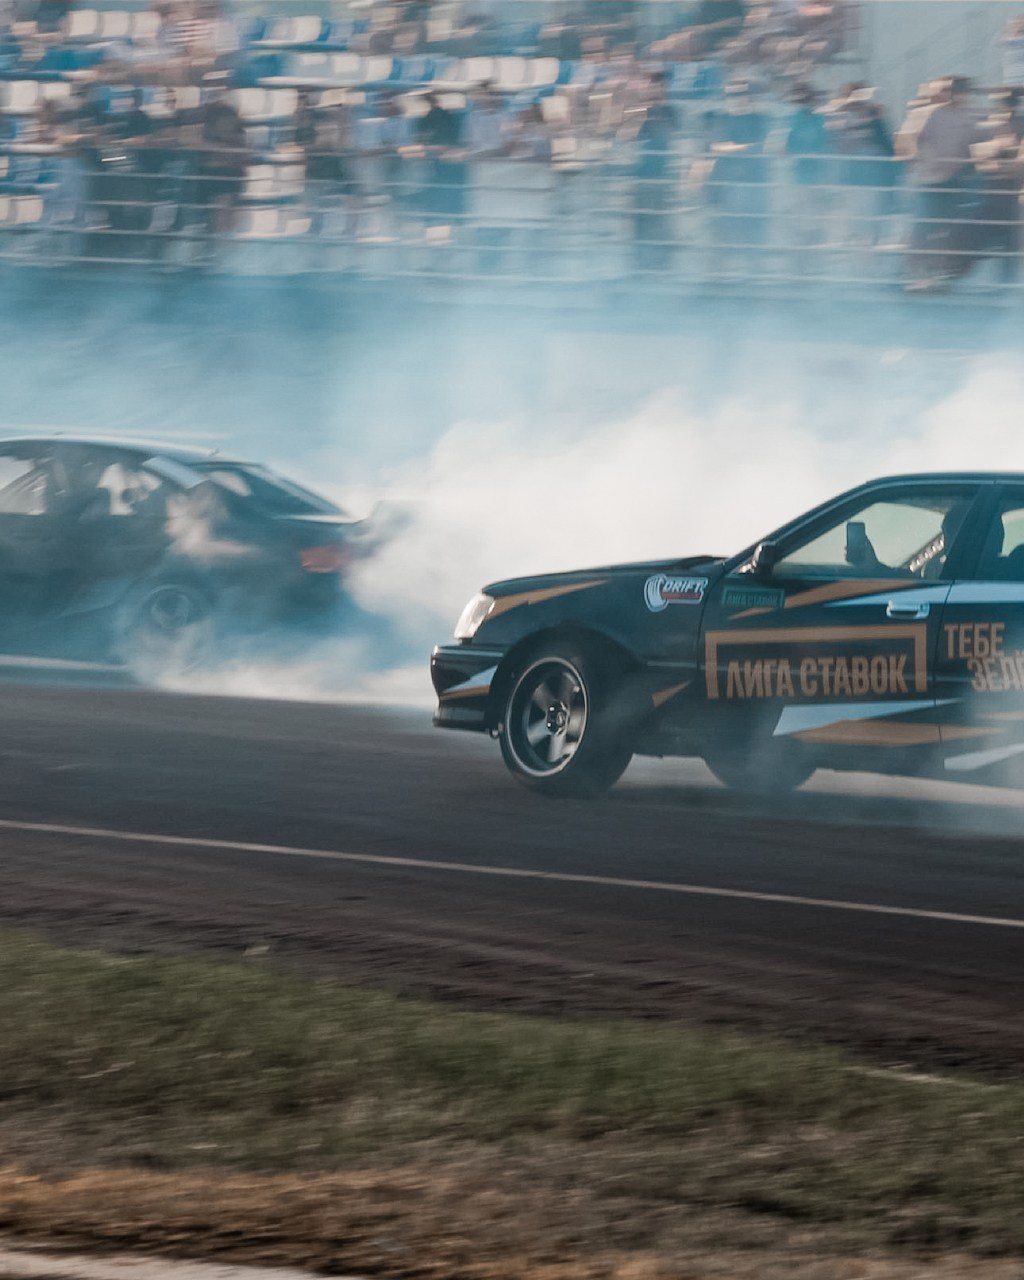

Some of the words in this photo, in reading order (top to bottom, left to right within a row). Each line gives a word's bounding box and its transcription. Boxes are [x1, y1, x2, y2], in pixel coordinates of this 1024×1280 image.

[663, 579, 702, 593] DRIFT
[944, 622, 1005, 659] ТЕБЕ
[726, 658, 795, 699] ЛИГА
[800, 654, 908, 697] СТАВОК
